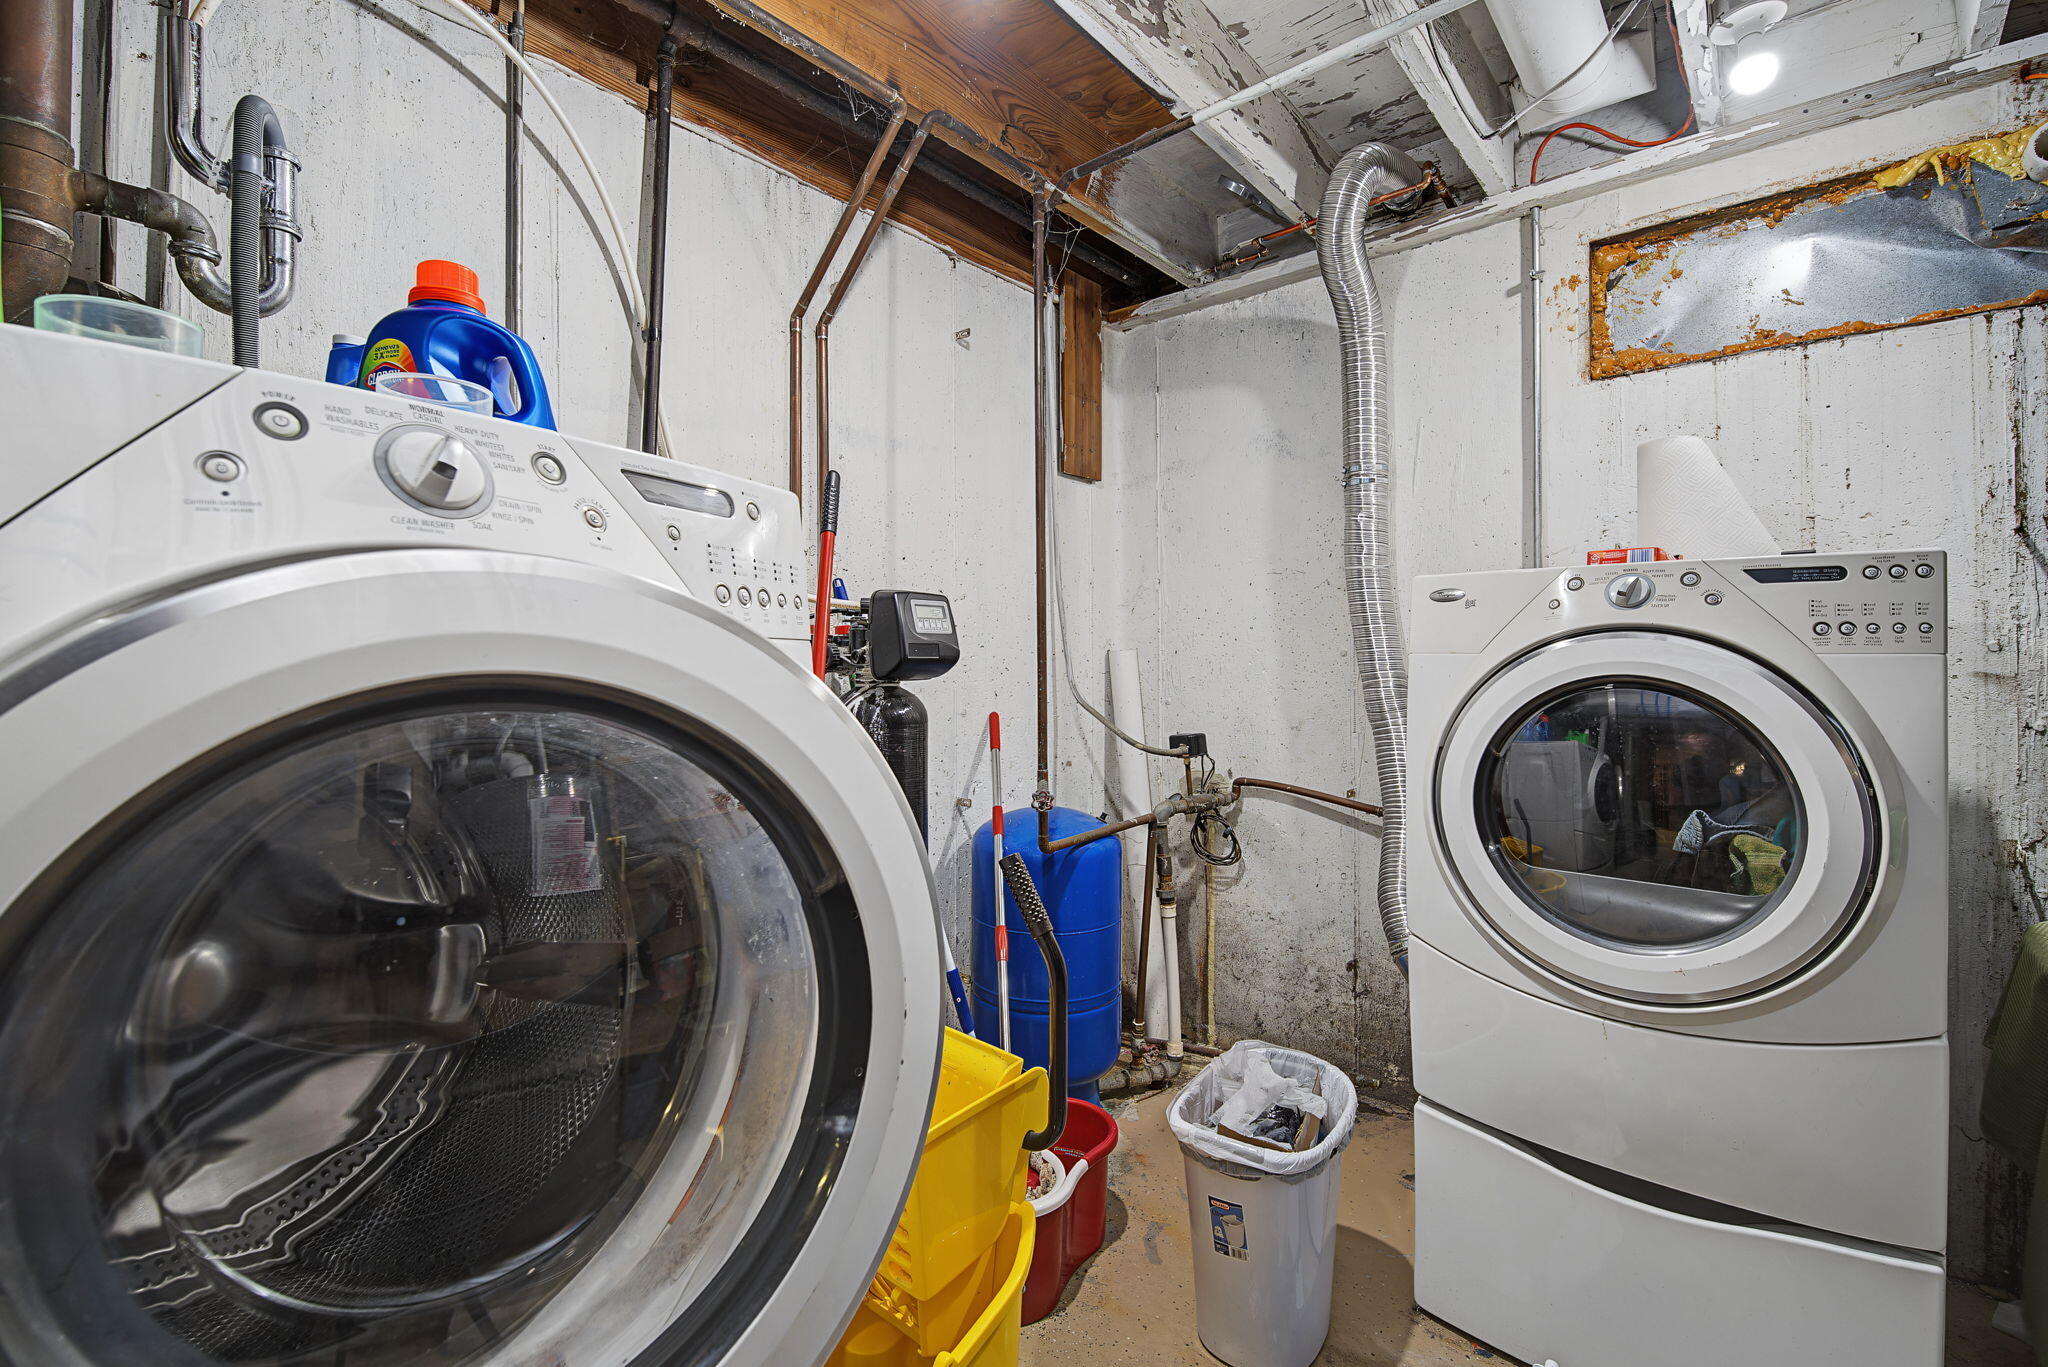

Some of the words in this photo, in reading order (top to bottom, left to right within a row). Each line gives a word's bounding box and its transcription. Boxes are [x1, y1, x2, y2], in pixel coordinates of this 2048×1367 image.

[324, 404, 350, 416] HAND
[364, 405, 404, 421] DELICATE
[408, 403, 445, 418] NORMAL
[325, 414, 379, 431] WASHABLES
[412, 412, 443, 425] CASUAL
[454, 425, 478, 436] HEAVY
[480, 430, 499, 440] DUTY
[475, 439, 504, 452] WHITEST
[489, 450, 516, 463] WHITES
[492, 461, 526, 474] SANITARY
[498, 499, 521, 511] DRAIN
[390, 515, 419, 526] CLEAN
[421, 518, 456, 531] WASHER
